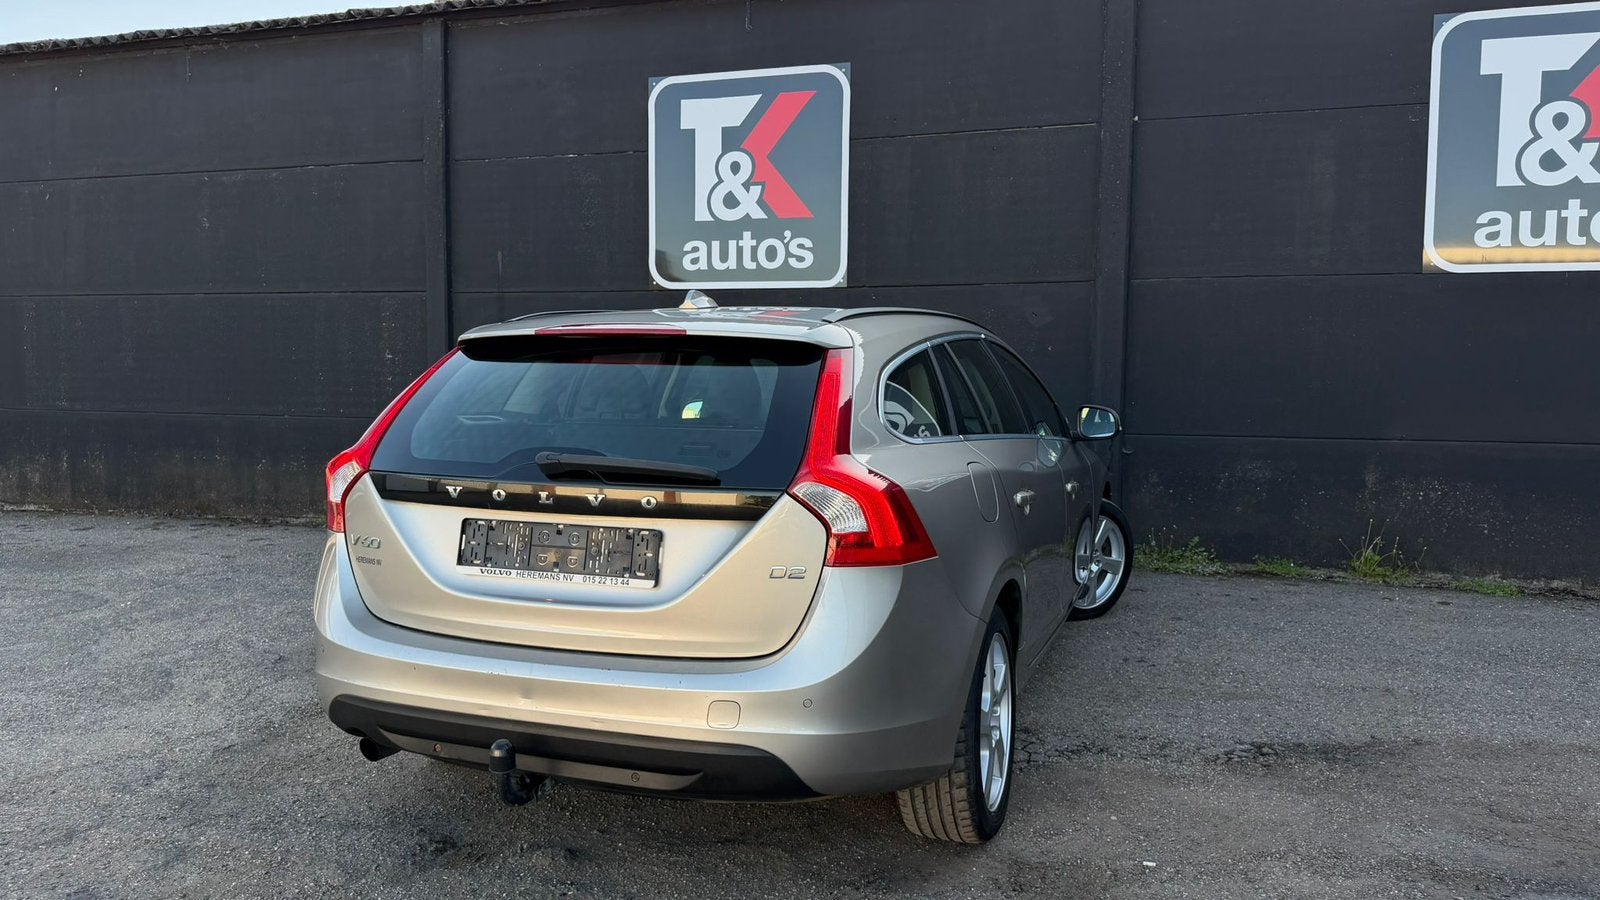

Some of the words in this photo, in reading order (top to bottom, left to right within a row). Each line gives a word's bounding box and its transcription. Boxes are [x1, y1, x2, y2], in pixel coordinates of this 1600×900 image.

[680, 90, 817, 222] T&K
[1473, 198, 1600, 248] aut
[682, 230, 814, 271] auto's
[445, 485, 658, 510] VOLVO
[351, 533, 381, 549] V60
[480, 568, 512, 576] VOLVO
[515, 570, 561, 581] HEREMANS
[562, 574, 574, 582] NV
[582, 576, 599, 584] 015
[599, 577, 608, 585] 22
[610, 578, 619, 586] 13
[620, 579, 630, 587] 44
[769, 565, 807, 580] D2
